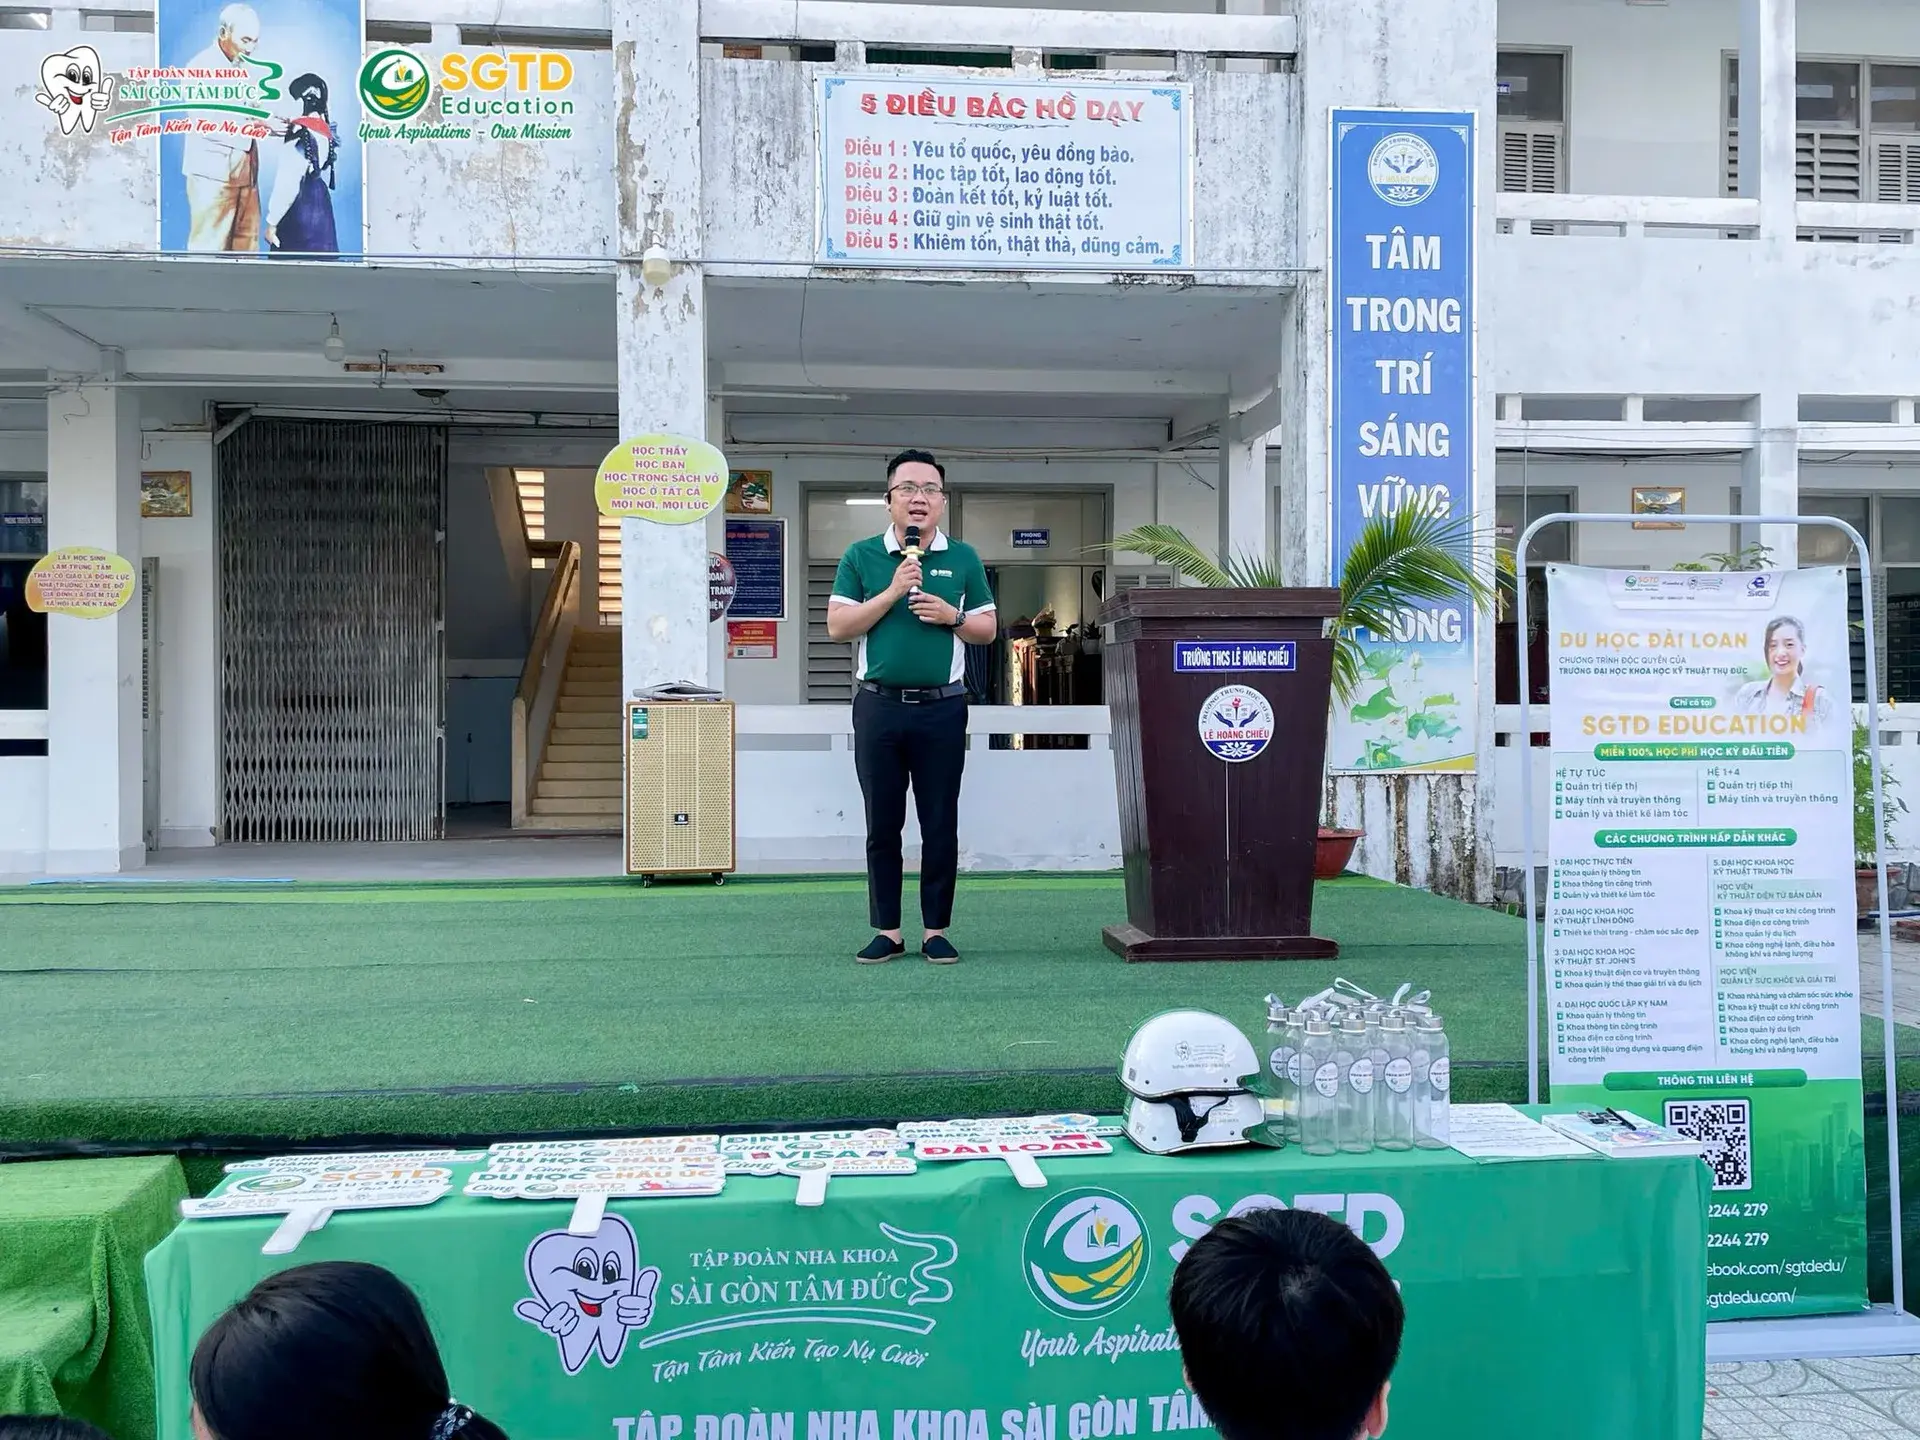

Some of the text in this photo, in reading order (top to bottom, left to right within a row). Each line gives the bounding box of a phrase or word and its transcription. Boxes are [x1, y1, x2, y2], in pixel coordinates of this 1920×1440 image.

[861, 88, 1144, 127] 5 ĐIỀU BÁC HỒ DẠY
[845, 138, 1134, 166] Điều 1 Yêu tổ quốc, yêu đồng bào.
[845, 163, 1117, 189] Điều 2 Học tập tốt, lao động tốt.
[845, 185, 1113, 210] Điều 3 Đoàn kết tốt, kỷ luật tốt.
[845, 208, 1104, 233] Điều 4 Giữ gìn vệ sinh thật tốt.
[845, 232, 1164, 257] Điều 5 Khiêm tốn, thật thà, dũng cảm.
[1366, 226, 1441, 270] TÂM
[1347, 298, 1461, 333] TRONG
[1376, 352, 1434, 394] TRÍ
[1359, 413, 1449, 457] SÁNG
[632, 447, 655, 456] HỌC
[636, 461, 658, 469] HỌC
[605, 474, 627, 482] HỌC
[672, 473, 700, 482] SÁCH
[623, 487, 646, 496] HỌC
[1358, 476, 1450, 519] VỮNG
[612, 501, 632, 510] MỌI
[663, 502, 683, 510] MỌI
[688, 500, 709, 509] LÚC
[1347, 608, 1461, 642] HONG
[1560, 629, 1748, 652] DU HỌC ĐÀI LOAN
[1212, 652, 1230, 666] THCS
[1232, 647, 1240, 666] LÊ
[1243, 647, 1266, 666] HOÀNG
[1268, 645, 1289, 666] CHIẾU
[1204, 727, 1269, 739] LÊ HOÀNG CHIẾU
[1582, 714, 1807, 735] SGTD EDUCATION
[1628, 748, 1653, 756] 100%
[1656, 748, 1679, 758] HỌC
[1700, 748, 1723, 758] HỌC
[1657, 1072, 1753, 1086] THÔNG TIN LIÊN HỆ
[923, 1142, 1104, 1155] ĐÀI LOAN
[1708, 1203, 1768, 1217] 2244 279
[1708, 1233, 1769, 1247] 2244 279
[690, 1248, 899, 1272] TẬP ĐOÀN NHA KHOA
[1707, 1257, 1847, 1277] ebook.com/sgtdedu/
[670, 1272, 908, 1305] SÀI GÒN TÂM ĐỨC
[1021, 1328, 1080, 1368] Your
[652, 1338, 929, 1383] Tận Tâm Kiến Tạo Nụ Cười
[1001, 1401, 1056, 1440] SÀI
[1068, 1395, 1138, 1440] GÒN
